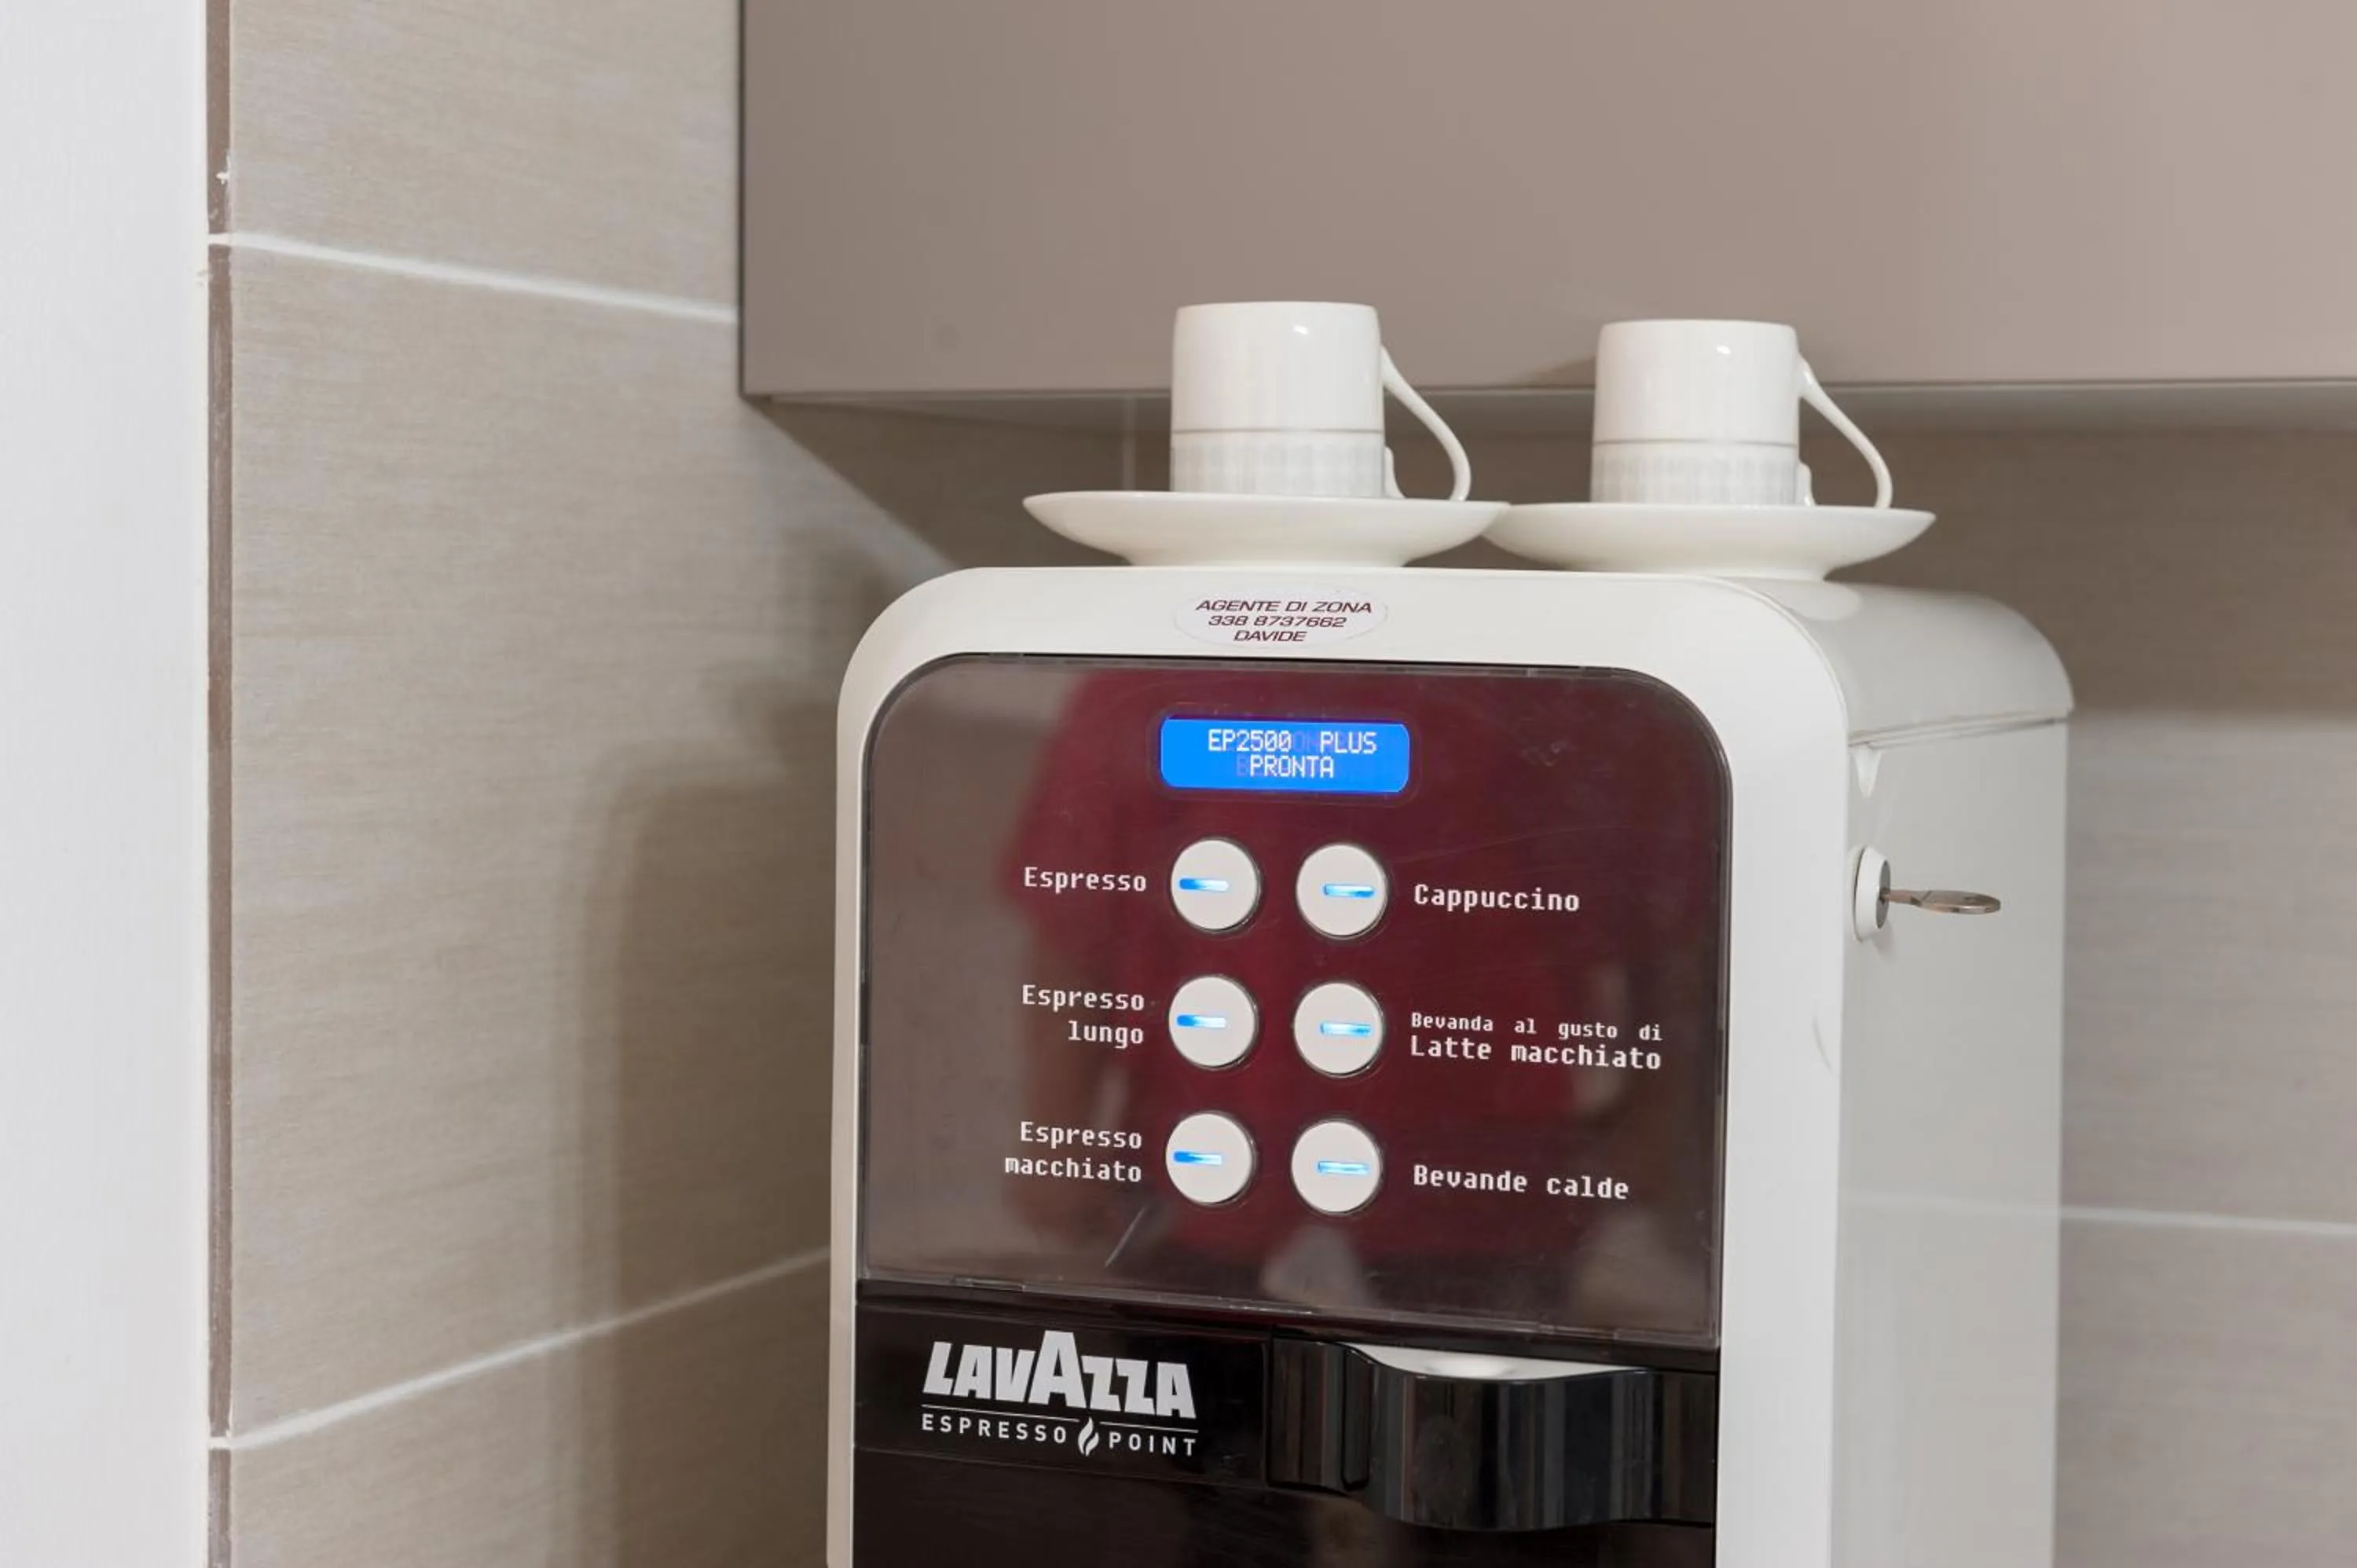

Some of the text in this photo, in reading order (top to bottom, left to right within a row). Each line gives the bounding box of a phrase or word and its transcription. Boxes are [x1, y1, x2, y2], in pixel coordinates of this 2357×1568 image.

[1195, 600, 1373, 614] AGENTE DI ZONA
[1208, 616, 1347, 628] 338 8737662
[1233, 630, 1308, 642] DAVIDE
[1208, 728, 1378, 754] EP2500 PLUS
[1249, 755, 1334, 778] PRONTA
[1023, 866, 1147, 893] Espresso
[1413, 884, 1581, 913] Cappuccino
[1021, 984, 1145, 1013] Espresso
[1068, 1020, 1145, 1050] lungo
[1411, 1012, 1663, 1042] Bevanda al gusto di
[1410, 1035, 1662, 1070] Latte macchiato
[1020, 1121, 1143, 1149] Espresso
[1004, 1156, 1142, 1182] macchiato
[1413, 1164, 1630, 1200] Bevande calde
[922, 1329, 1197, 1420] LAVAZZA
[921, 1413, 1197, 1456] ESPRESSO POINT
